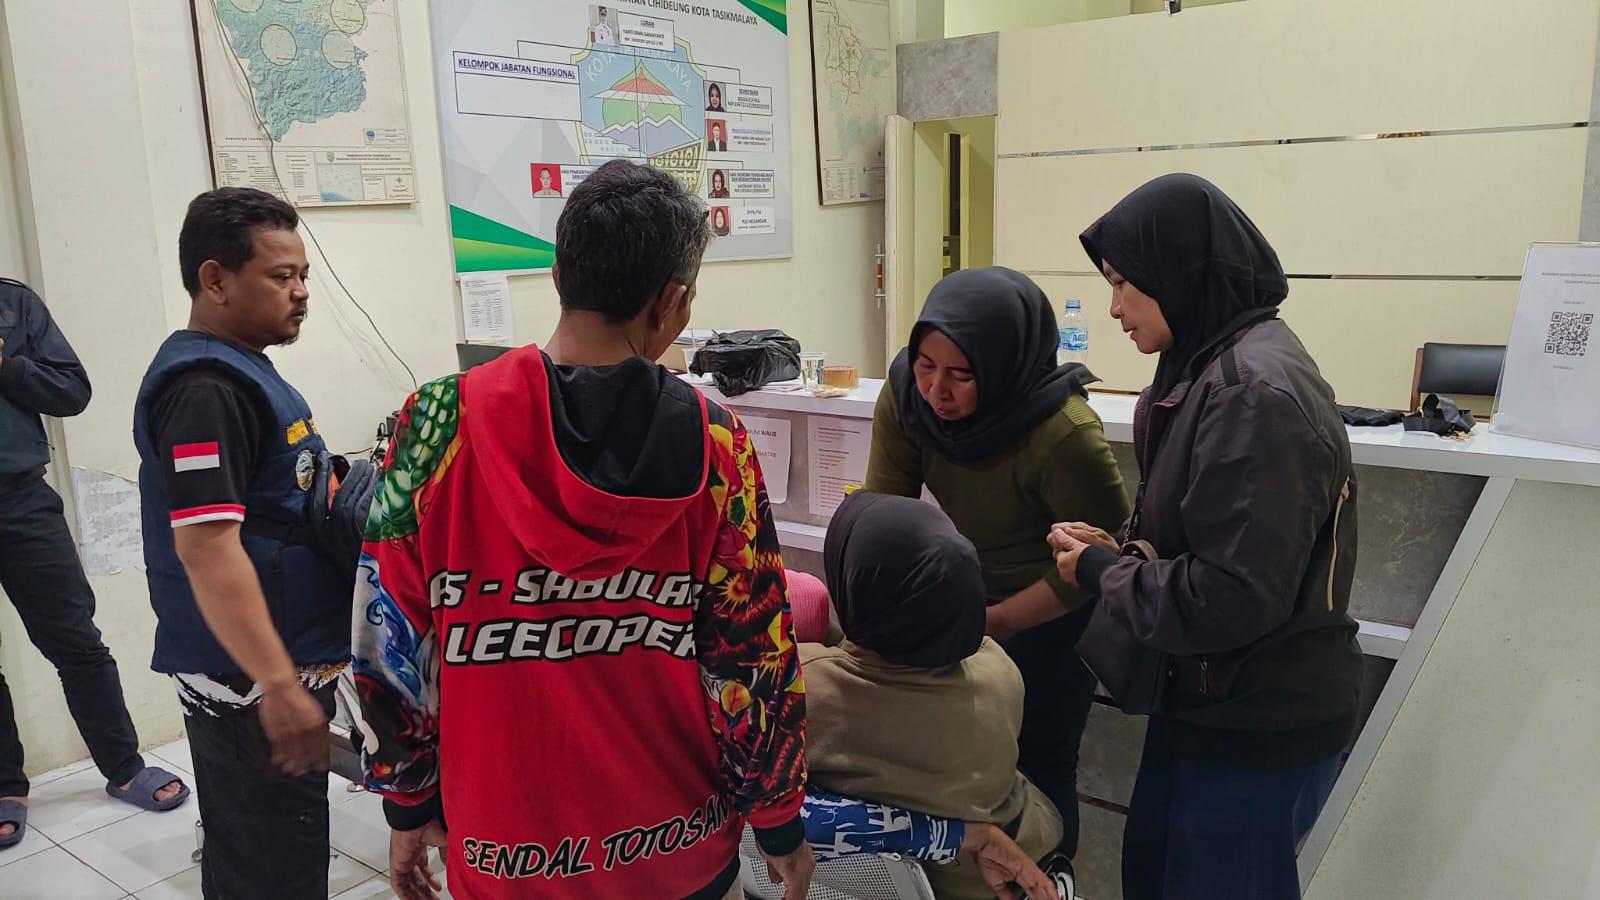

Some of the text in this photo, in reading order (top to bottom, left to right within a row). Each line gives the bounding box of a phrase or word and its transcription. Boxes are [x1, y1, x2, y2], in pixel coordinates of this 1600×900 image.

[648, 0, 690, 14] CIHIDEUNG
[692, 7, 711, 18] KOTA
[712, 9, 759, 26] TASIKMALAYA
[458, 58, 576, 79] KELOMPOK JABATAN FUNGSIONAL
[463, 837, 594, 880] SENDAL
